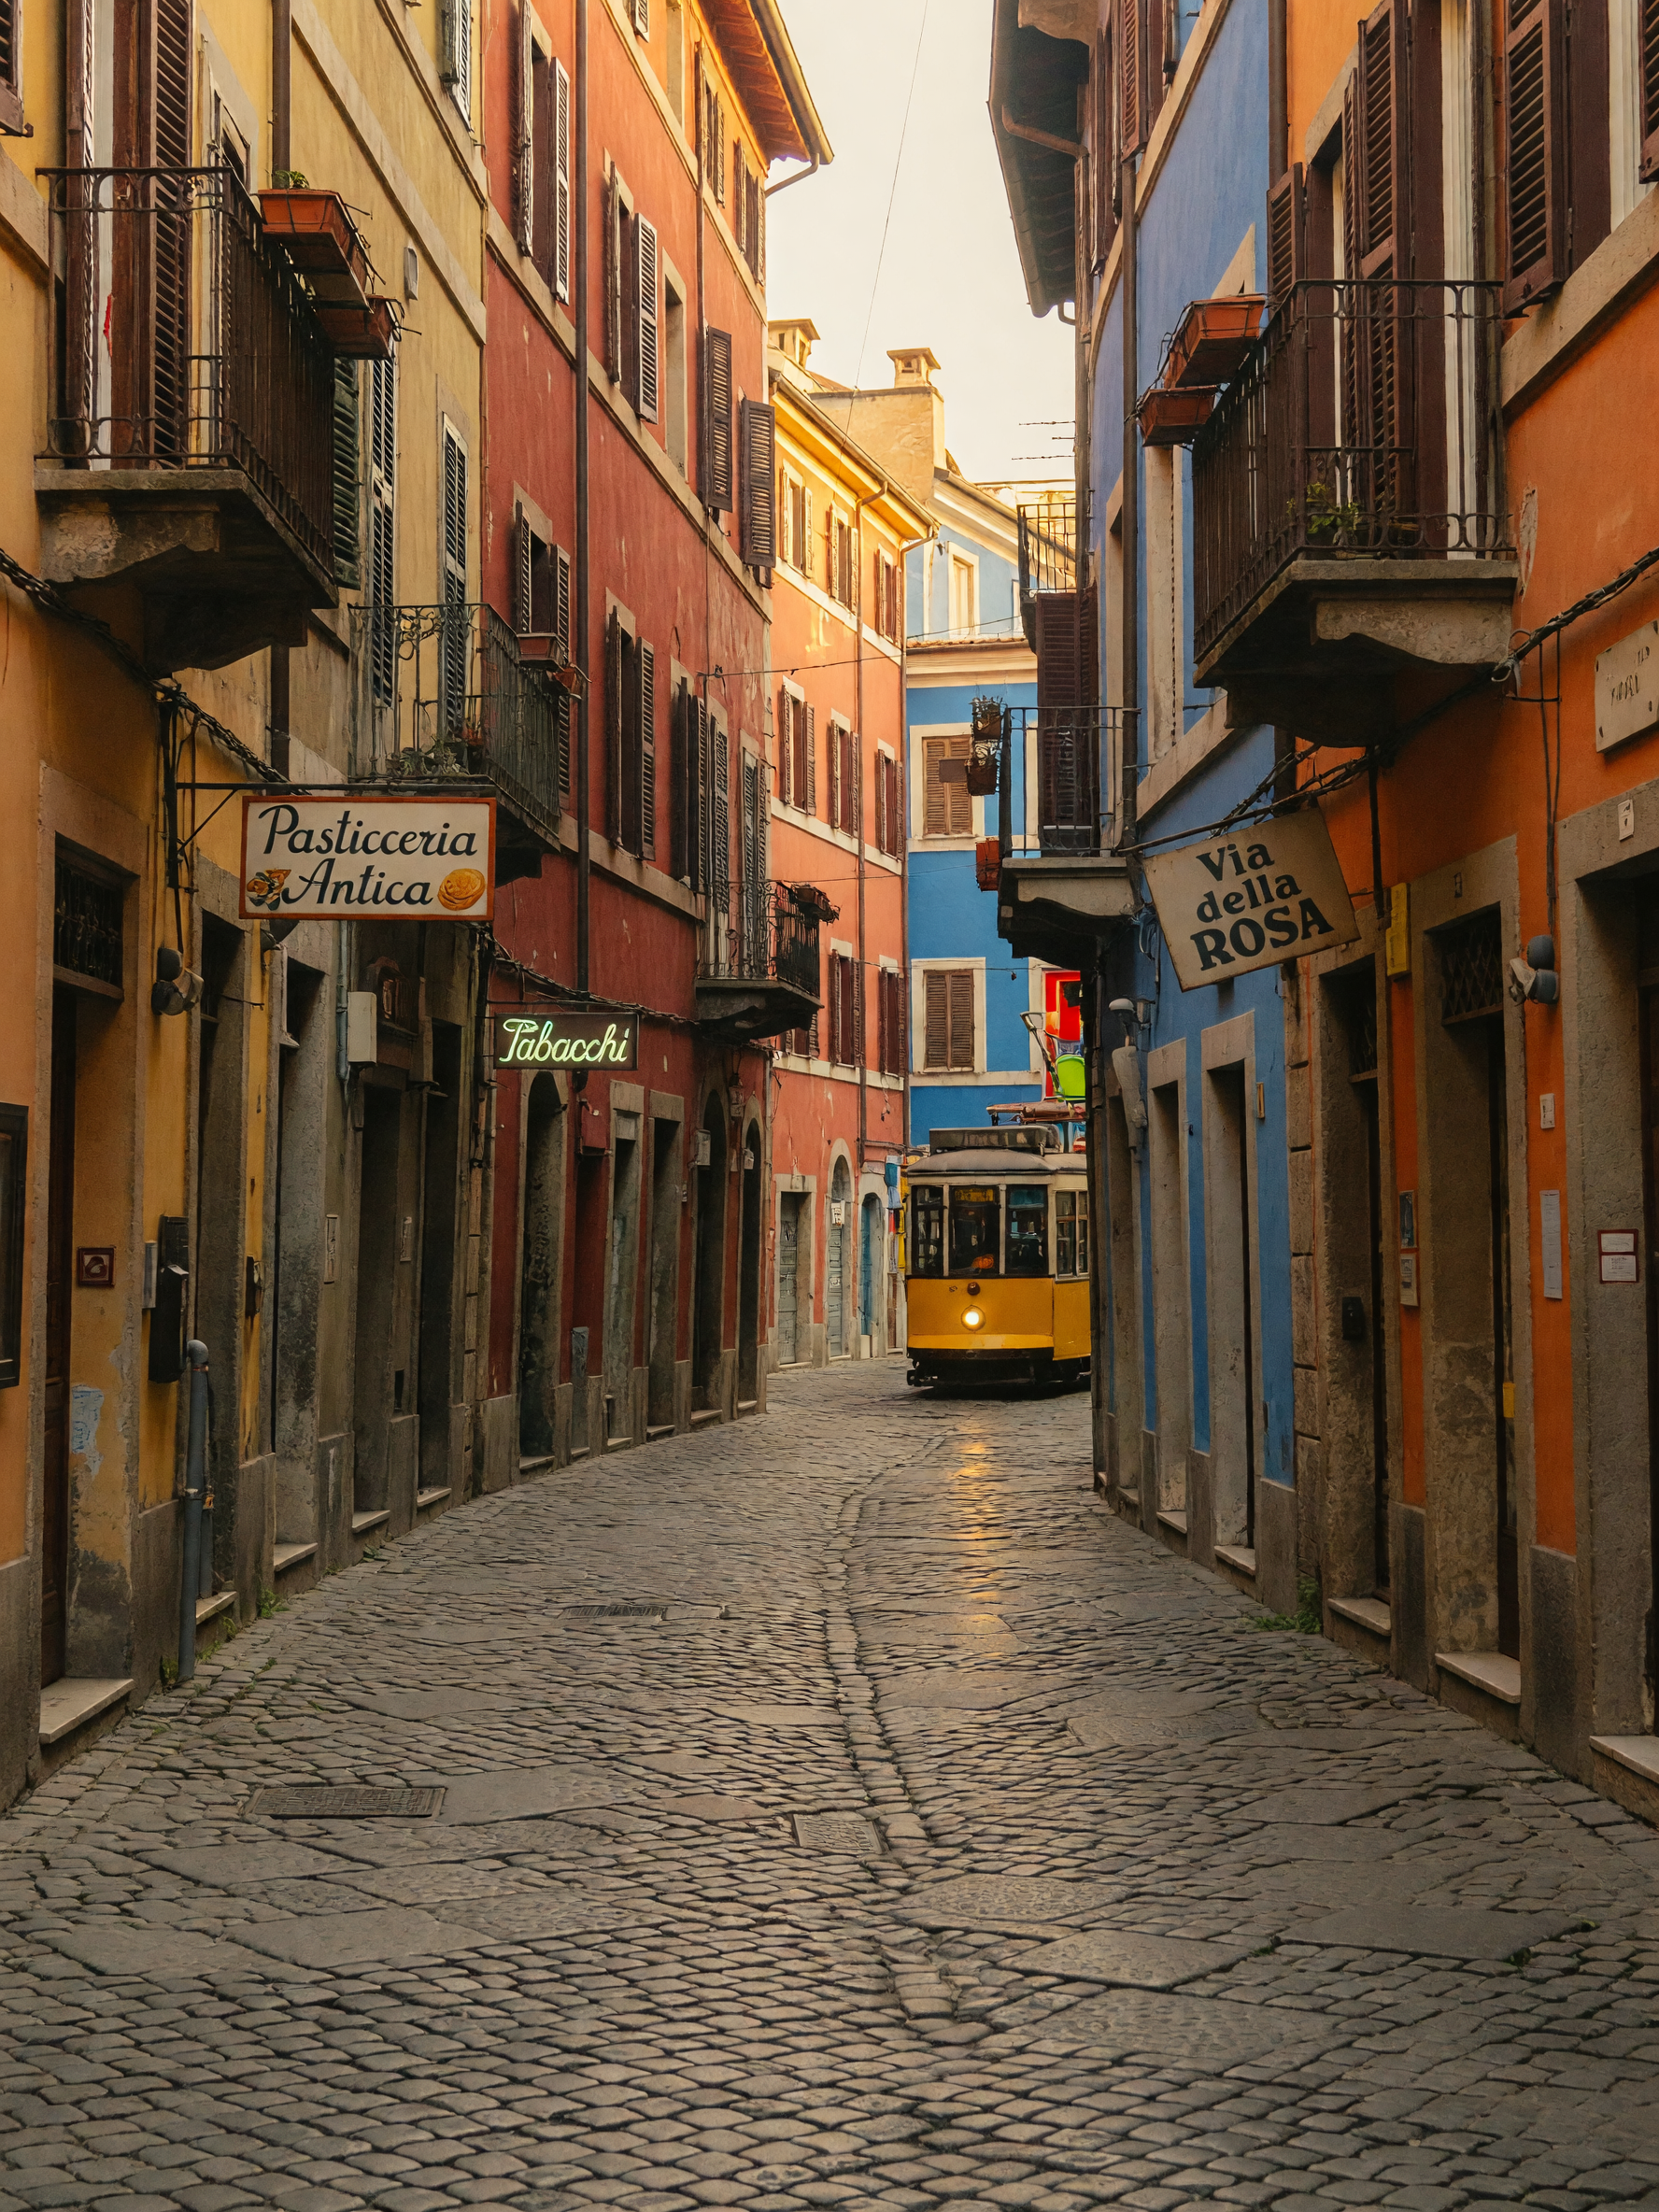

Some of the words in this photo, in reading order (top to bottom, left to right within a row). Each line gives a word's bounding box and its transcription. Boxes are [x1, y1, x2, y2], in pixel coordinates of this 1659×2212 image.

[260, 804, 478, 857] Pasticceria
[283, 858, 433, 905] Antica
[1196, 843, 1275, 882] Via
[1197, 873, 1302, 923] della
[1190, 897, 1335, 971] ROSA
[500, 1017, 631, 1063] Tabacchi
